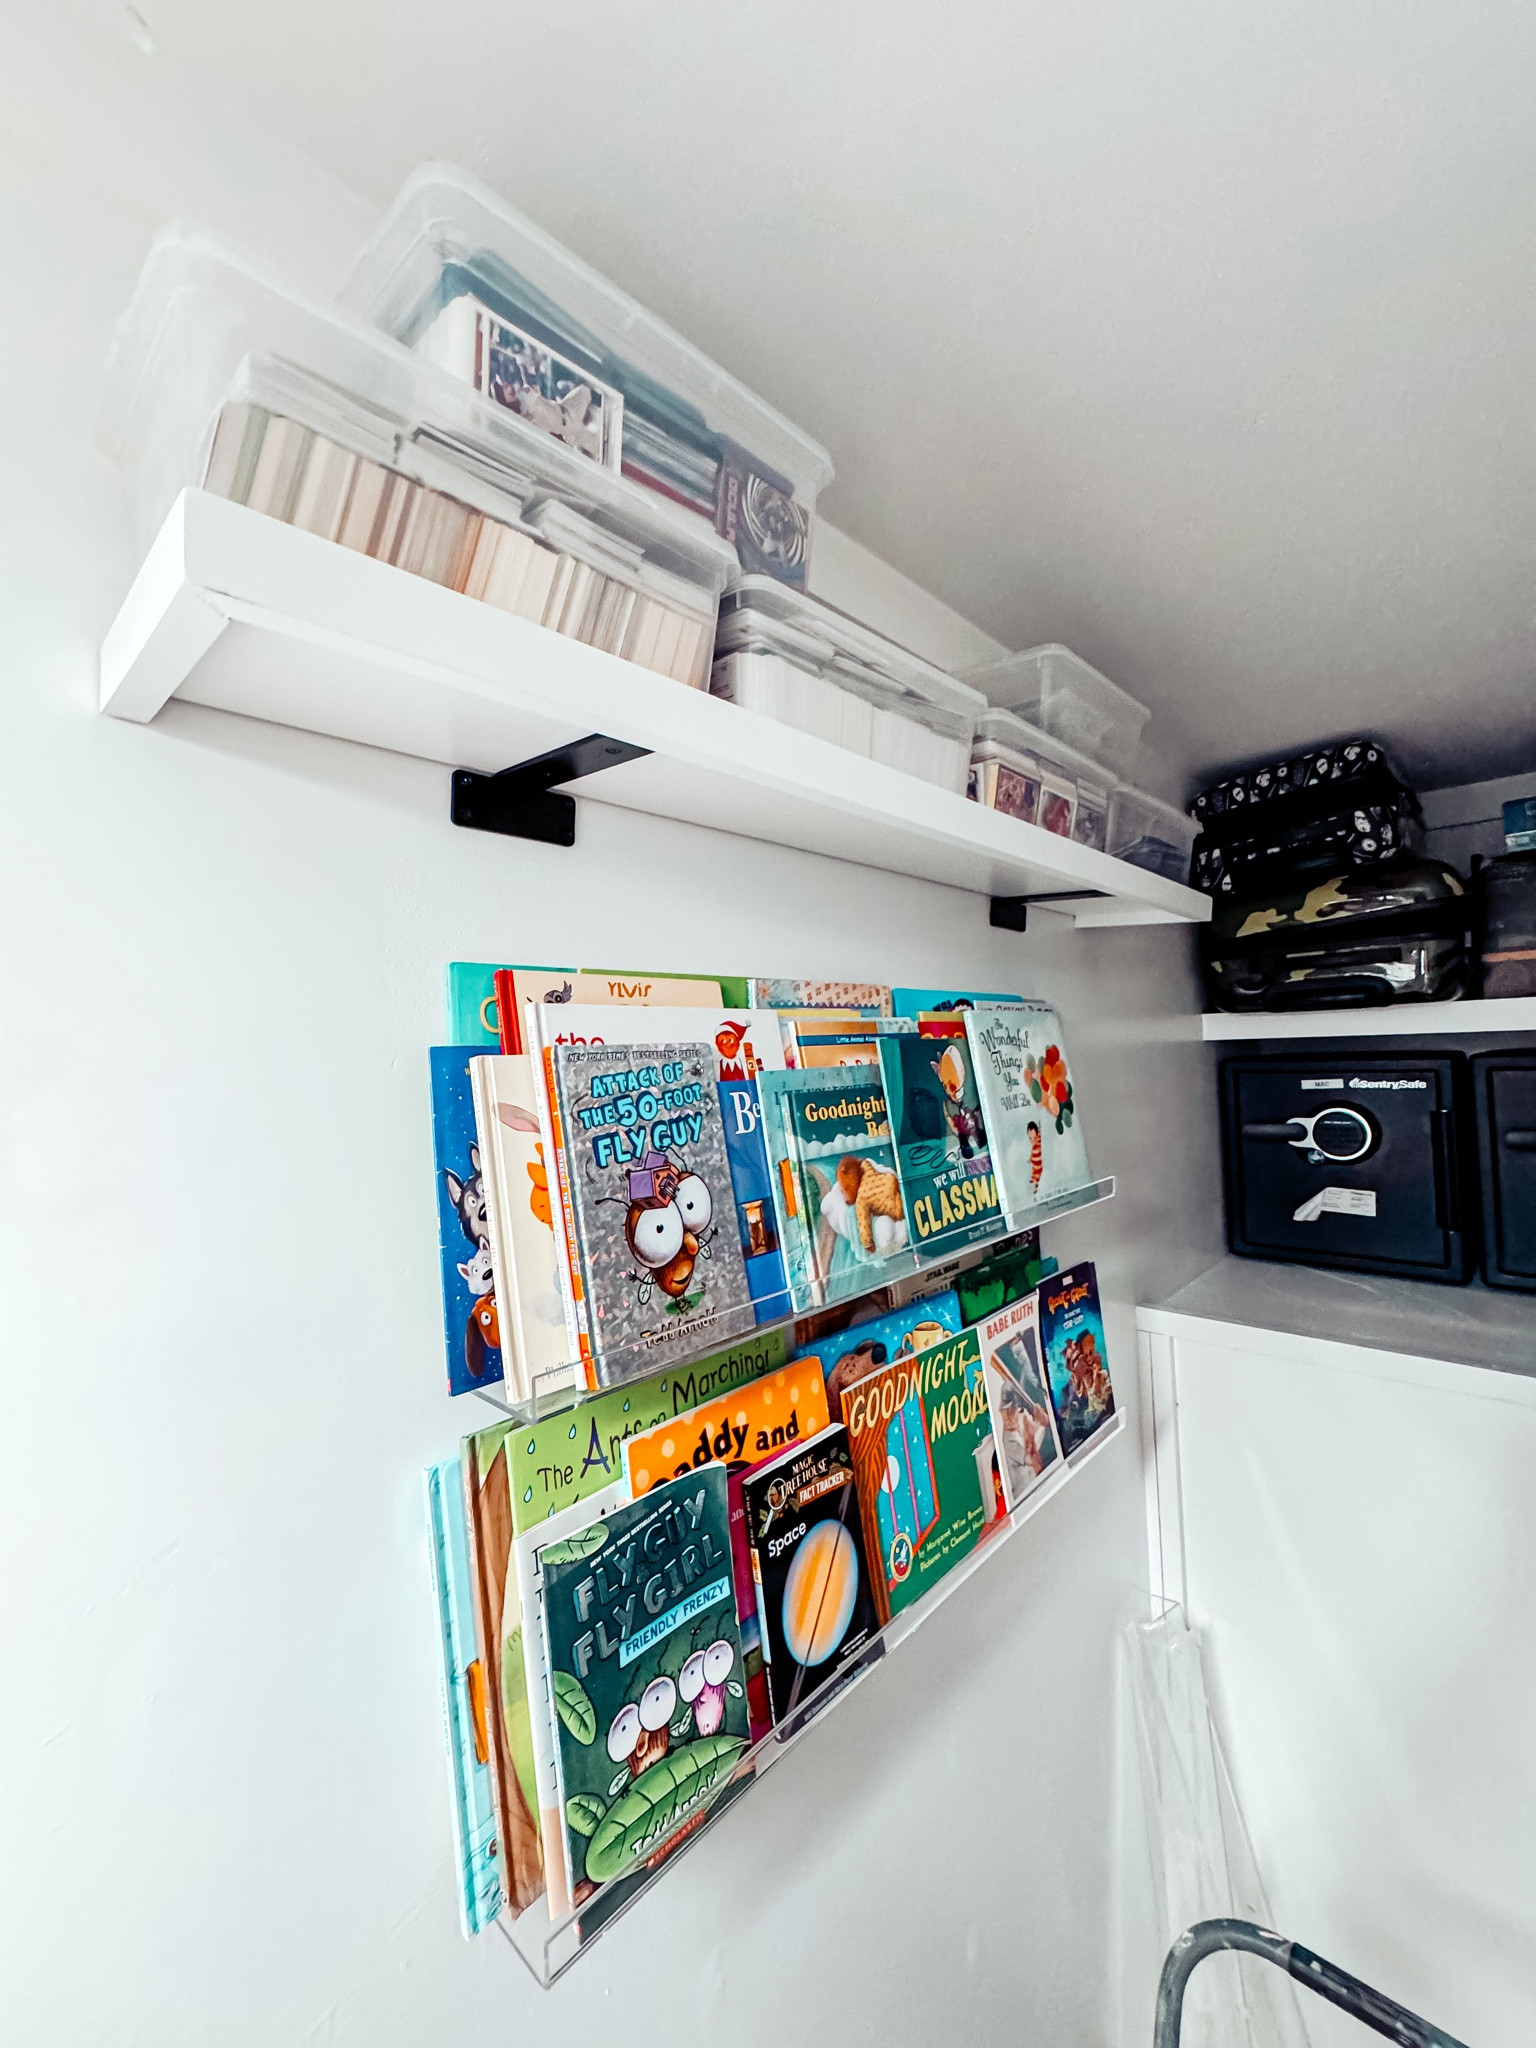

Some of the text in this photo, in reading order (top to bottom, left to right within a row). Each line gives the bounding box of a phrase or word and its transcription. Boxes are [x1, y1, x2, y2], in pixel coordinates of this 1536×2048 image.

[568, 1053, 584, 1063] NEW
[587, 1052, 604, 1062] YORK
[606, 1051, 630, 1061] TIMES
[979, 1026, 1029, 1052] Wonderful
[591, 1062, 684, 1099] ATTACK OF
[1003, 1071, 1020, 1092] You
[1358, 1079, 1428, 1090] SentrySafe
[579, 1083, 702, 1130] THE 50-FOOT
[805, 1095, 887, 1122] Goodnight
[592, 1112, 703, 1168] FLY GUY
[933, 1173, 948, 1189] we
[948, 1160, 966, 1181] will
[986, 1301, 1033, 1341] BABE RUTH
[850, 1339, 968, 1437] GOODNIGHT
[537, 1465, 573, 1492] The
[672, 1349, 770, 1416] Marching!
[756, 1409, 800, 1451] and
[931, 1380, 985, 1443] MOON
[779, 1457, 828, 1500] TREE HOUSE
[792, 1454, 814, 1475] MAGIC
[799, 1471, 844, 1504] FACT TRACKER
[590, 1499, 672, 1568] NEW YORK TIMES BESTSELLING SERIES
[768, 1522, 807, 1558] Space
[926, 1528, 951, 1552] Margaret
[952, 1519, 967, 1531] Wise
[573, 1541, 637, 1622] FLY
[643, 1489, 706, 1564] GUY
[572, 1593, 636, 1680] FLY
[644, 1534, 726, 1615] GIRL
[625, 1581, 725, 1656] FRIENDLY FRENZY
[654, 1810, 706, 1861] SCHOLASTIC
